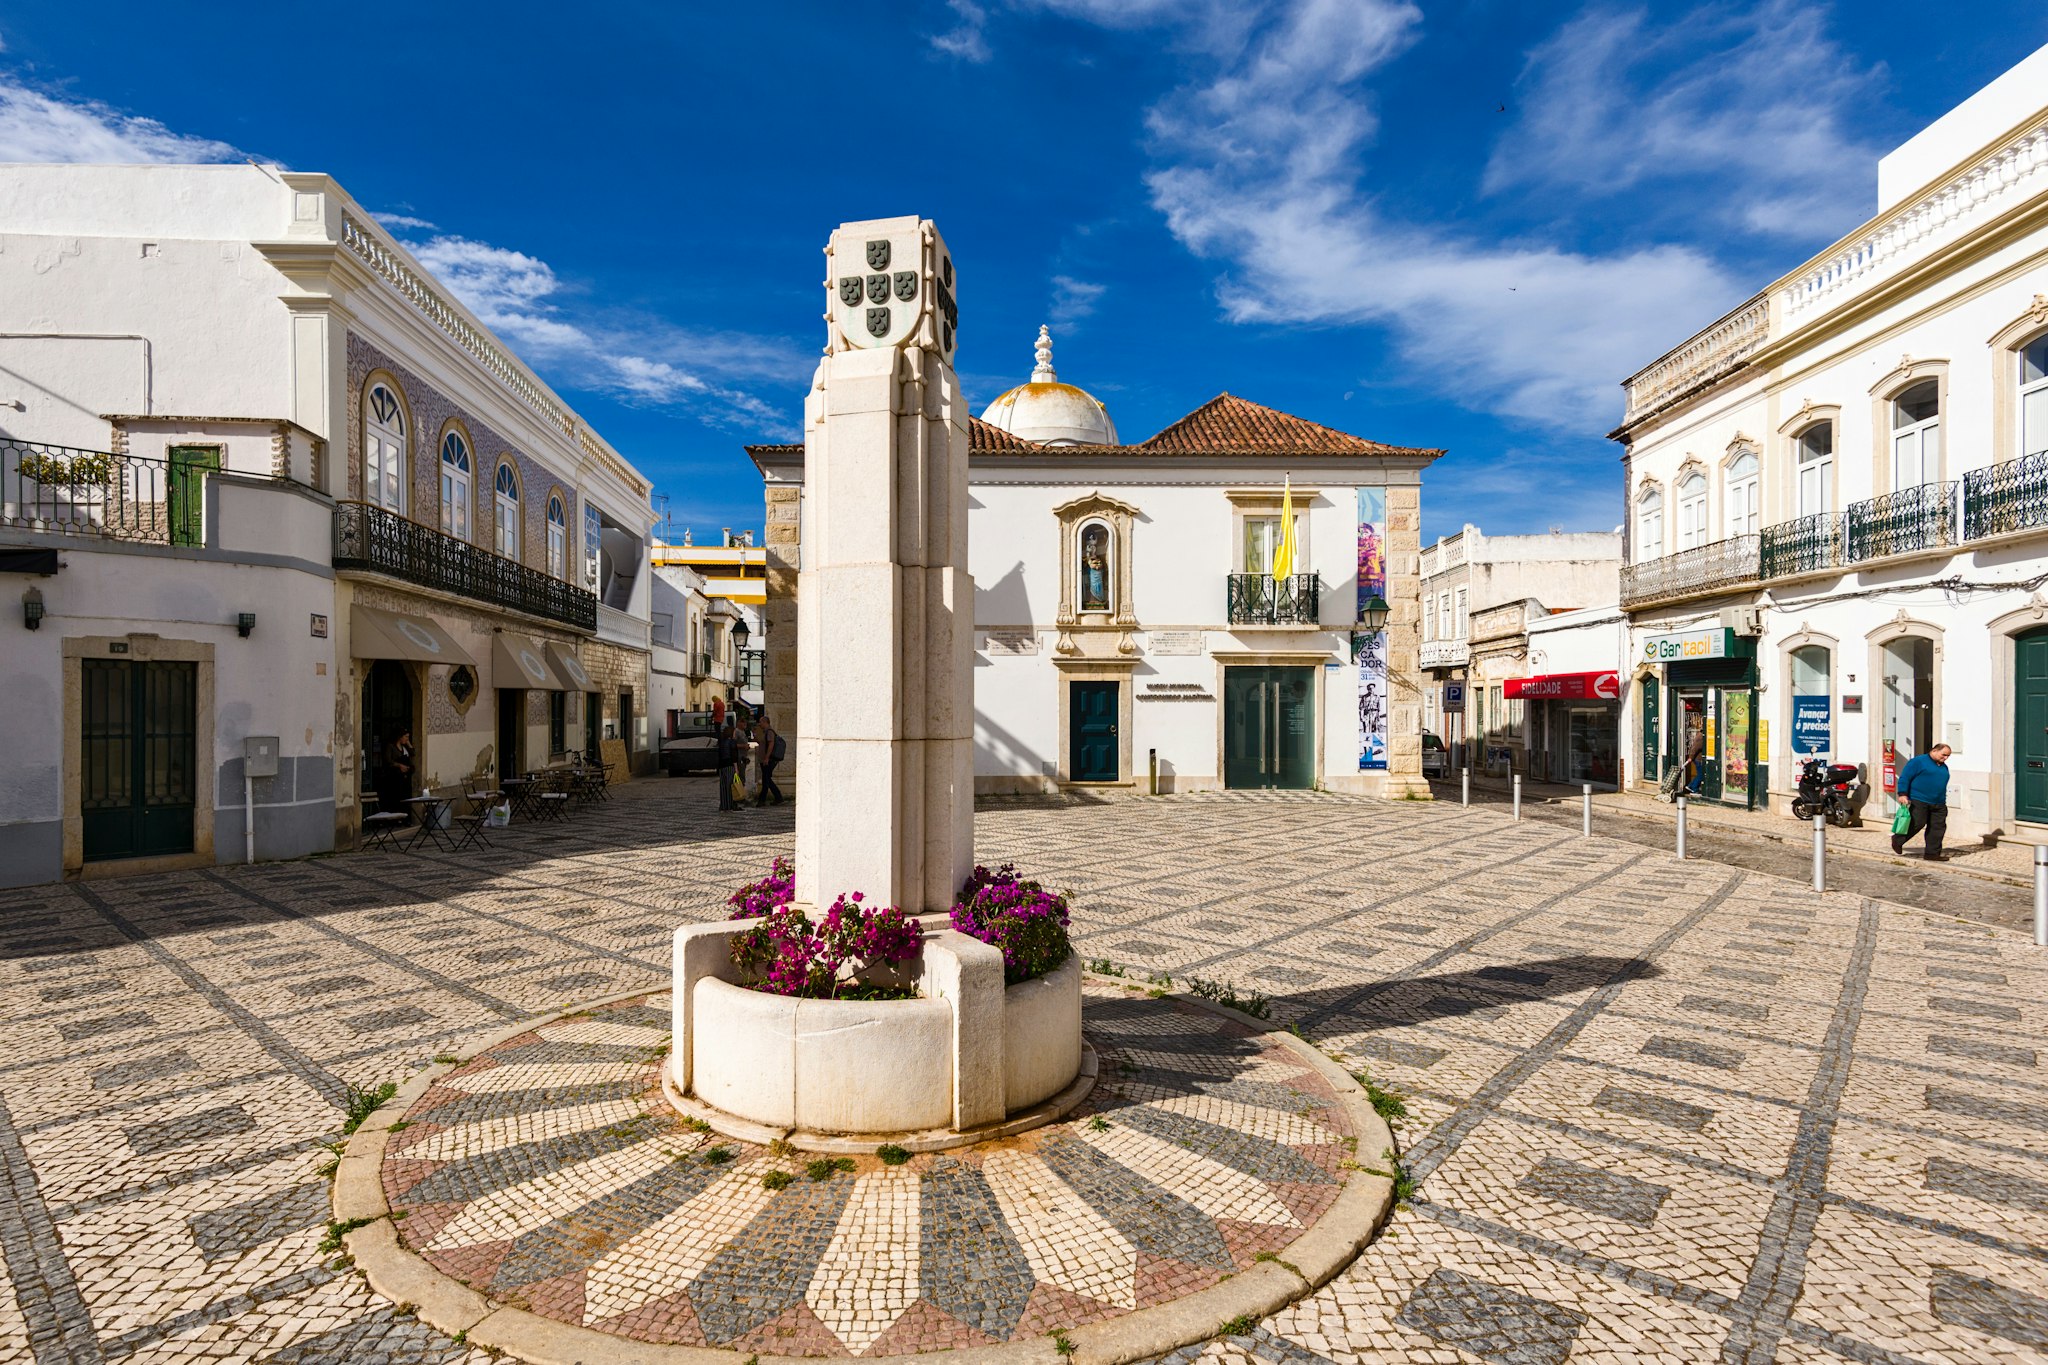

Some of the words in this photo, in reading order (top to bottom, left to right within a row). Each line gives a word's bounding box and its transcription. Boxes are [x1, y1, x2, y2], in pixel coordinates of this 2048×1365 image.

[1360, 650, 1375, 659] CA
[1360, 660, 1382, 668] DOR
[1450, 688, 1460, 700] P
[1521, 682, 1562, 695] FIDELIDADE
[1798, 707, 1829, 722] Avançar
[1795, 719, 1802, 730] é
